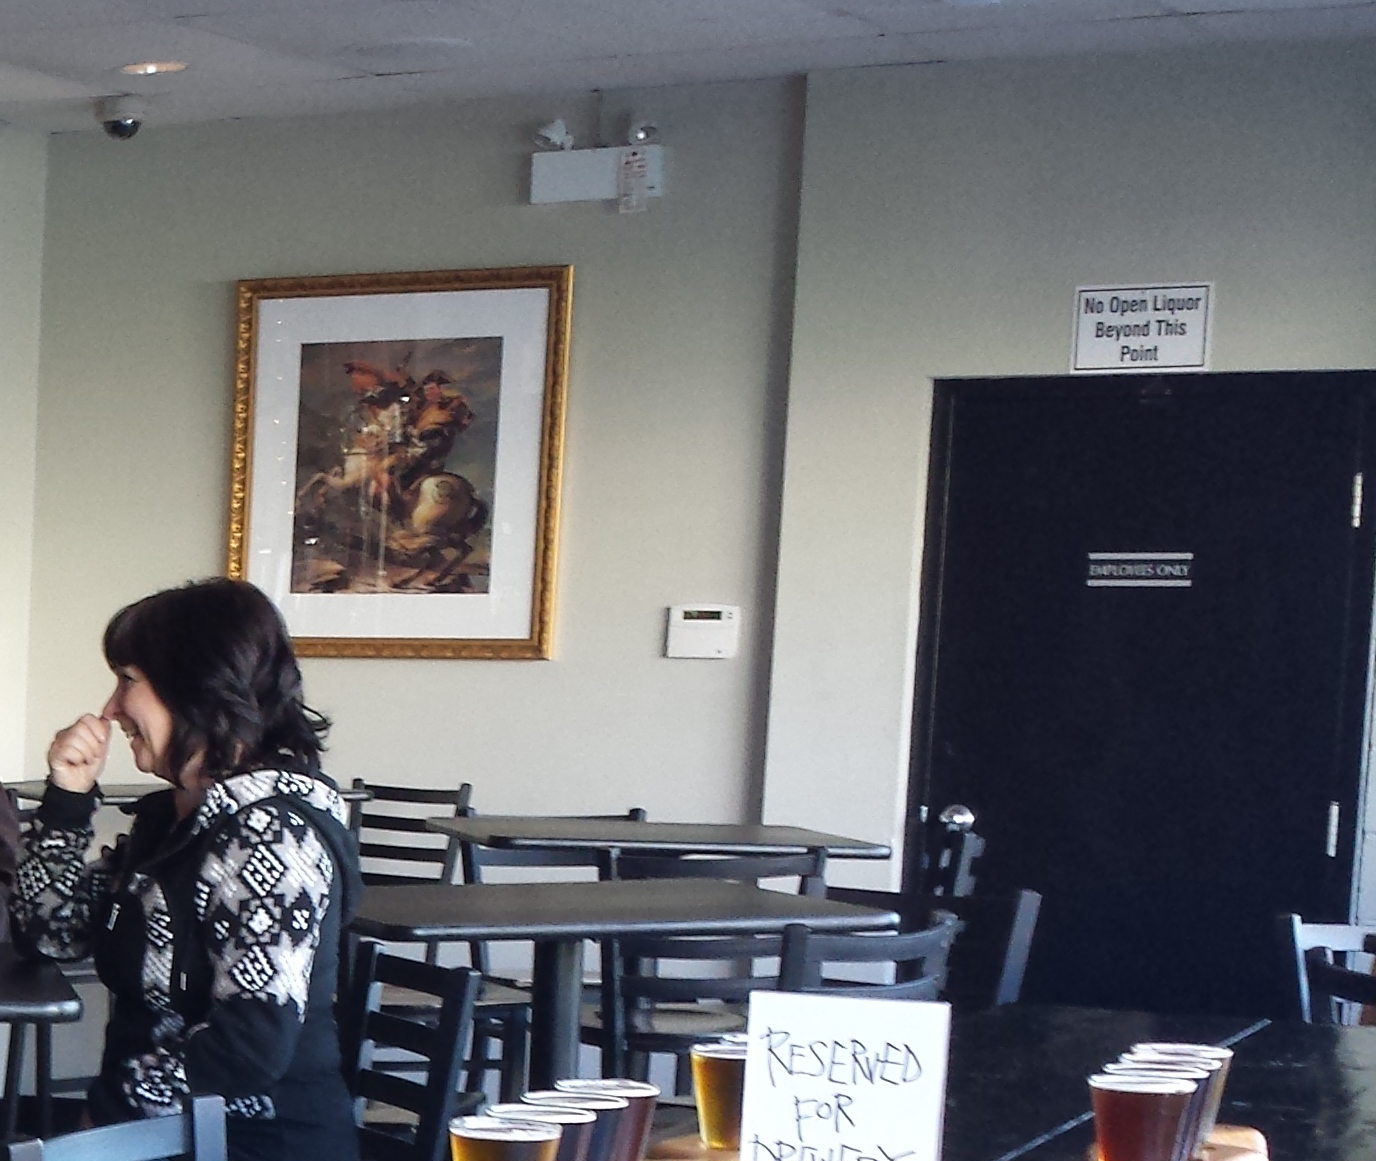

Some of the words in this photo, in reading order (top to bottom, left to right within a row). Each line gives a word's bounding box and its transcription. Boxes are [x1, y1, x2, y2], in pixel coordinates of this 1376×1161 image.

[1083, 298, 1104, 314] No
[1109, 296, 1148, 317] Open
[1152, 294, 1202, 315] Liquor
[1095, 320, 1151, 341] Beyond
[1155, 319, 1187, 337] This
[1120, 345, 1159, 362] Point
[1156, 563, 1191, 577] ONLY
[759, 1025, 922, 1088] RESERVED
[793, 1092, 856, 1142] FOR
